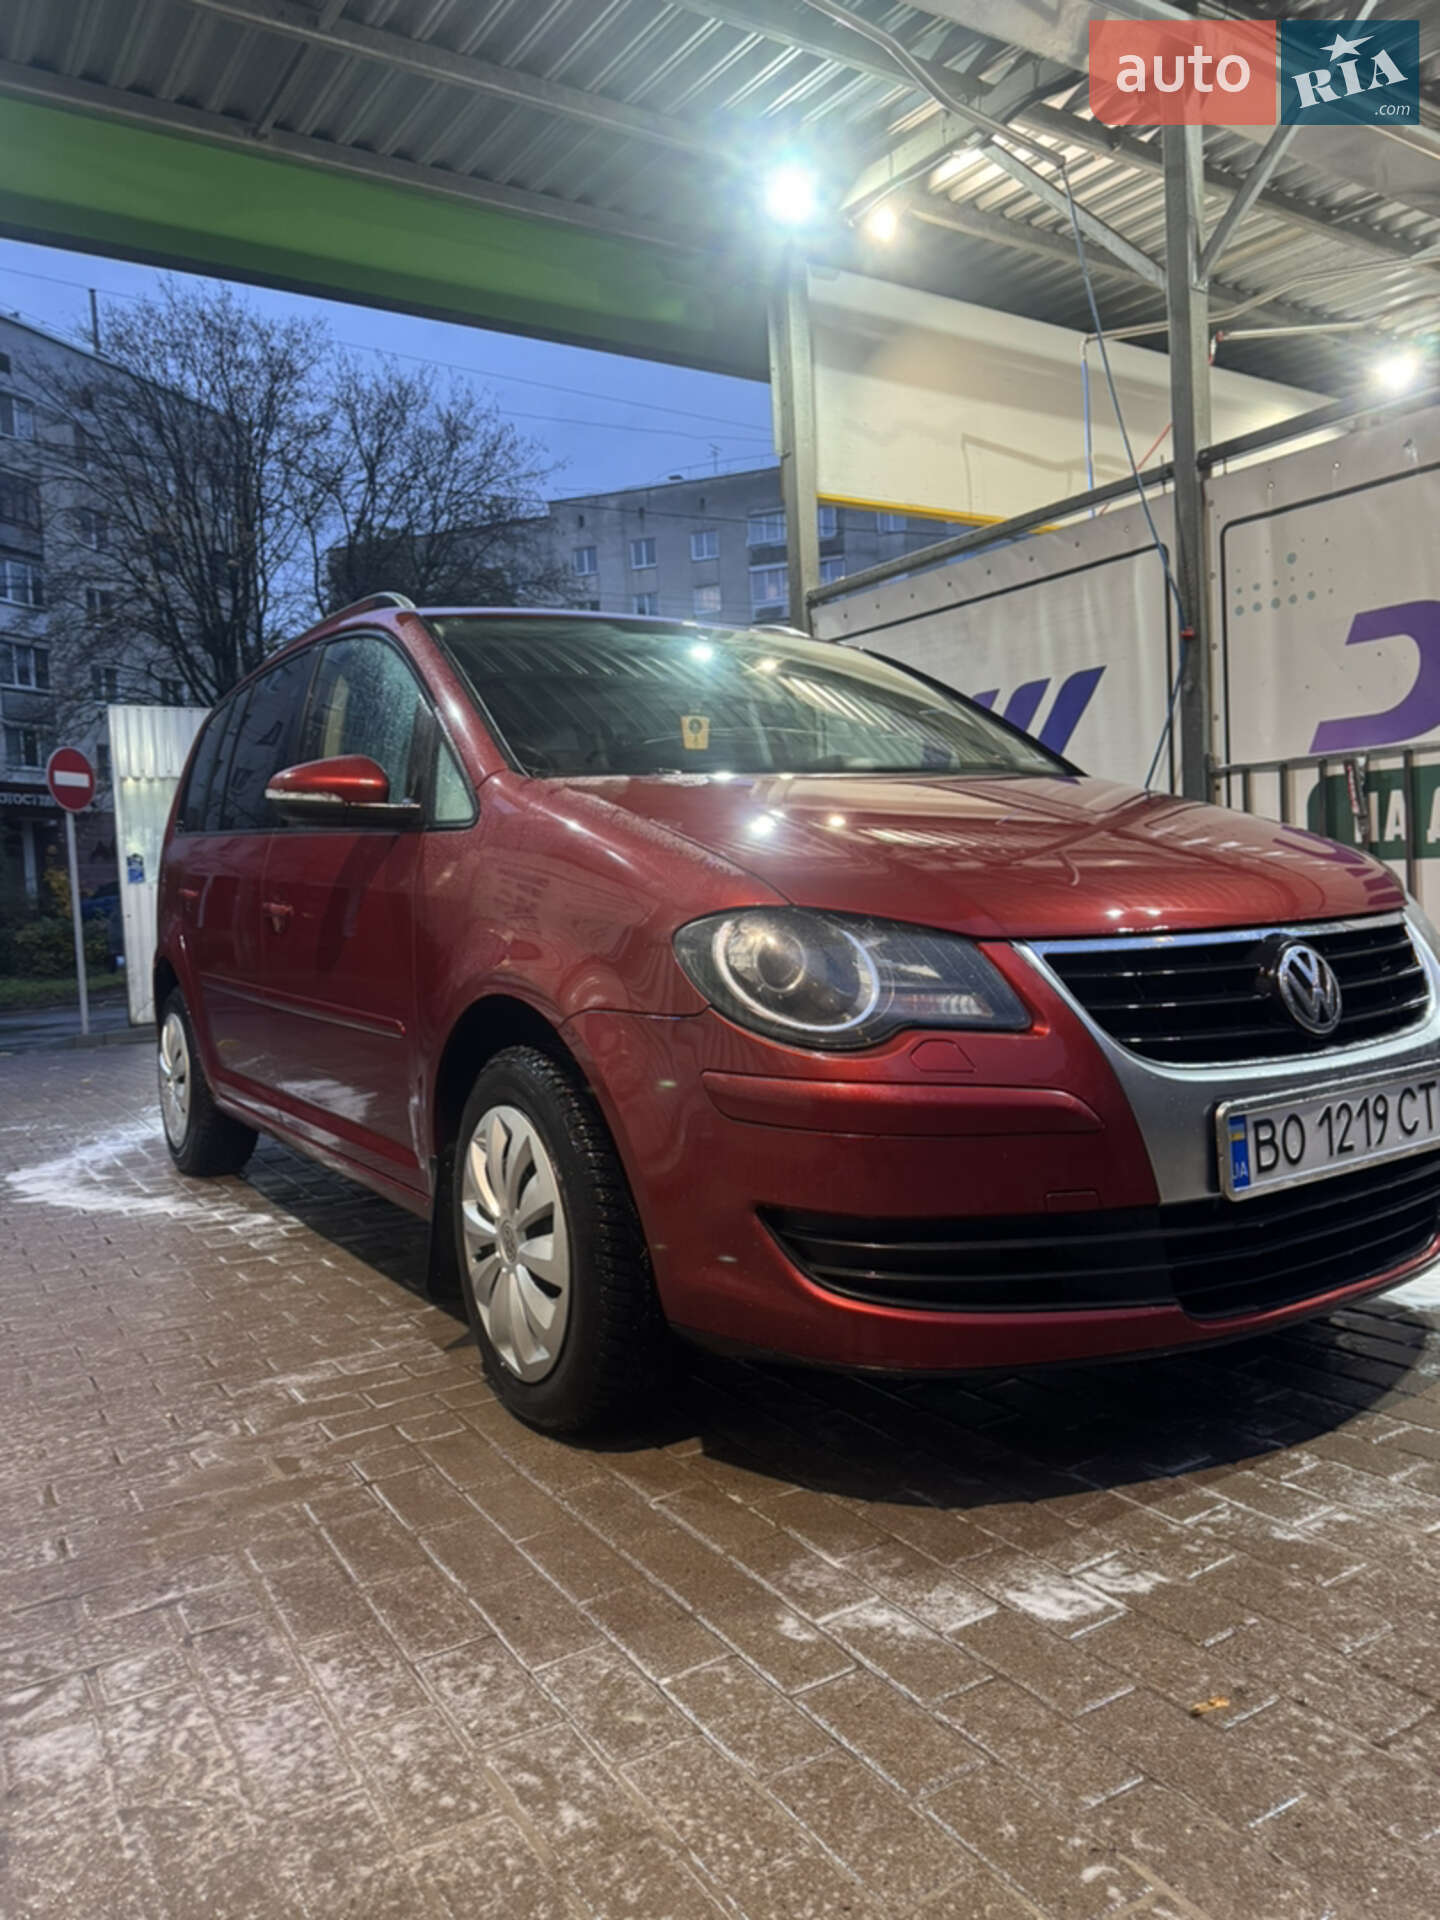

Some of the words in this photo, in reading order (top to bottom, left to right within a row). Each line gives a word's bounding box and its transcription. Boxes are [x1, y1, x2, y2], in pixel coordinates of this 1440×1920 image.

[1253, 1113, 1305, 1174] BO
[1317, 1094, 1389, 1157] 1219
[1398, 1081, 1437, 1136] CT
